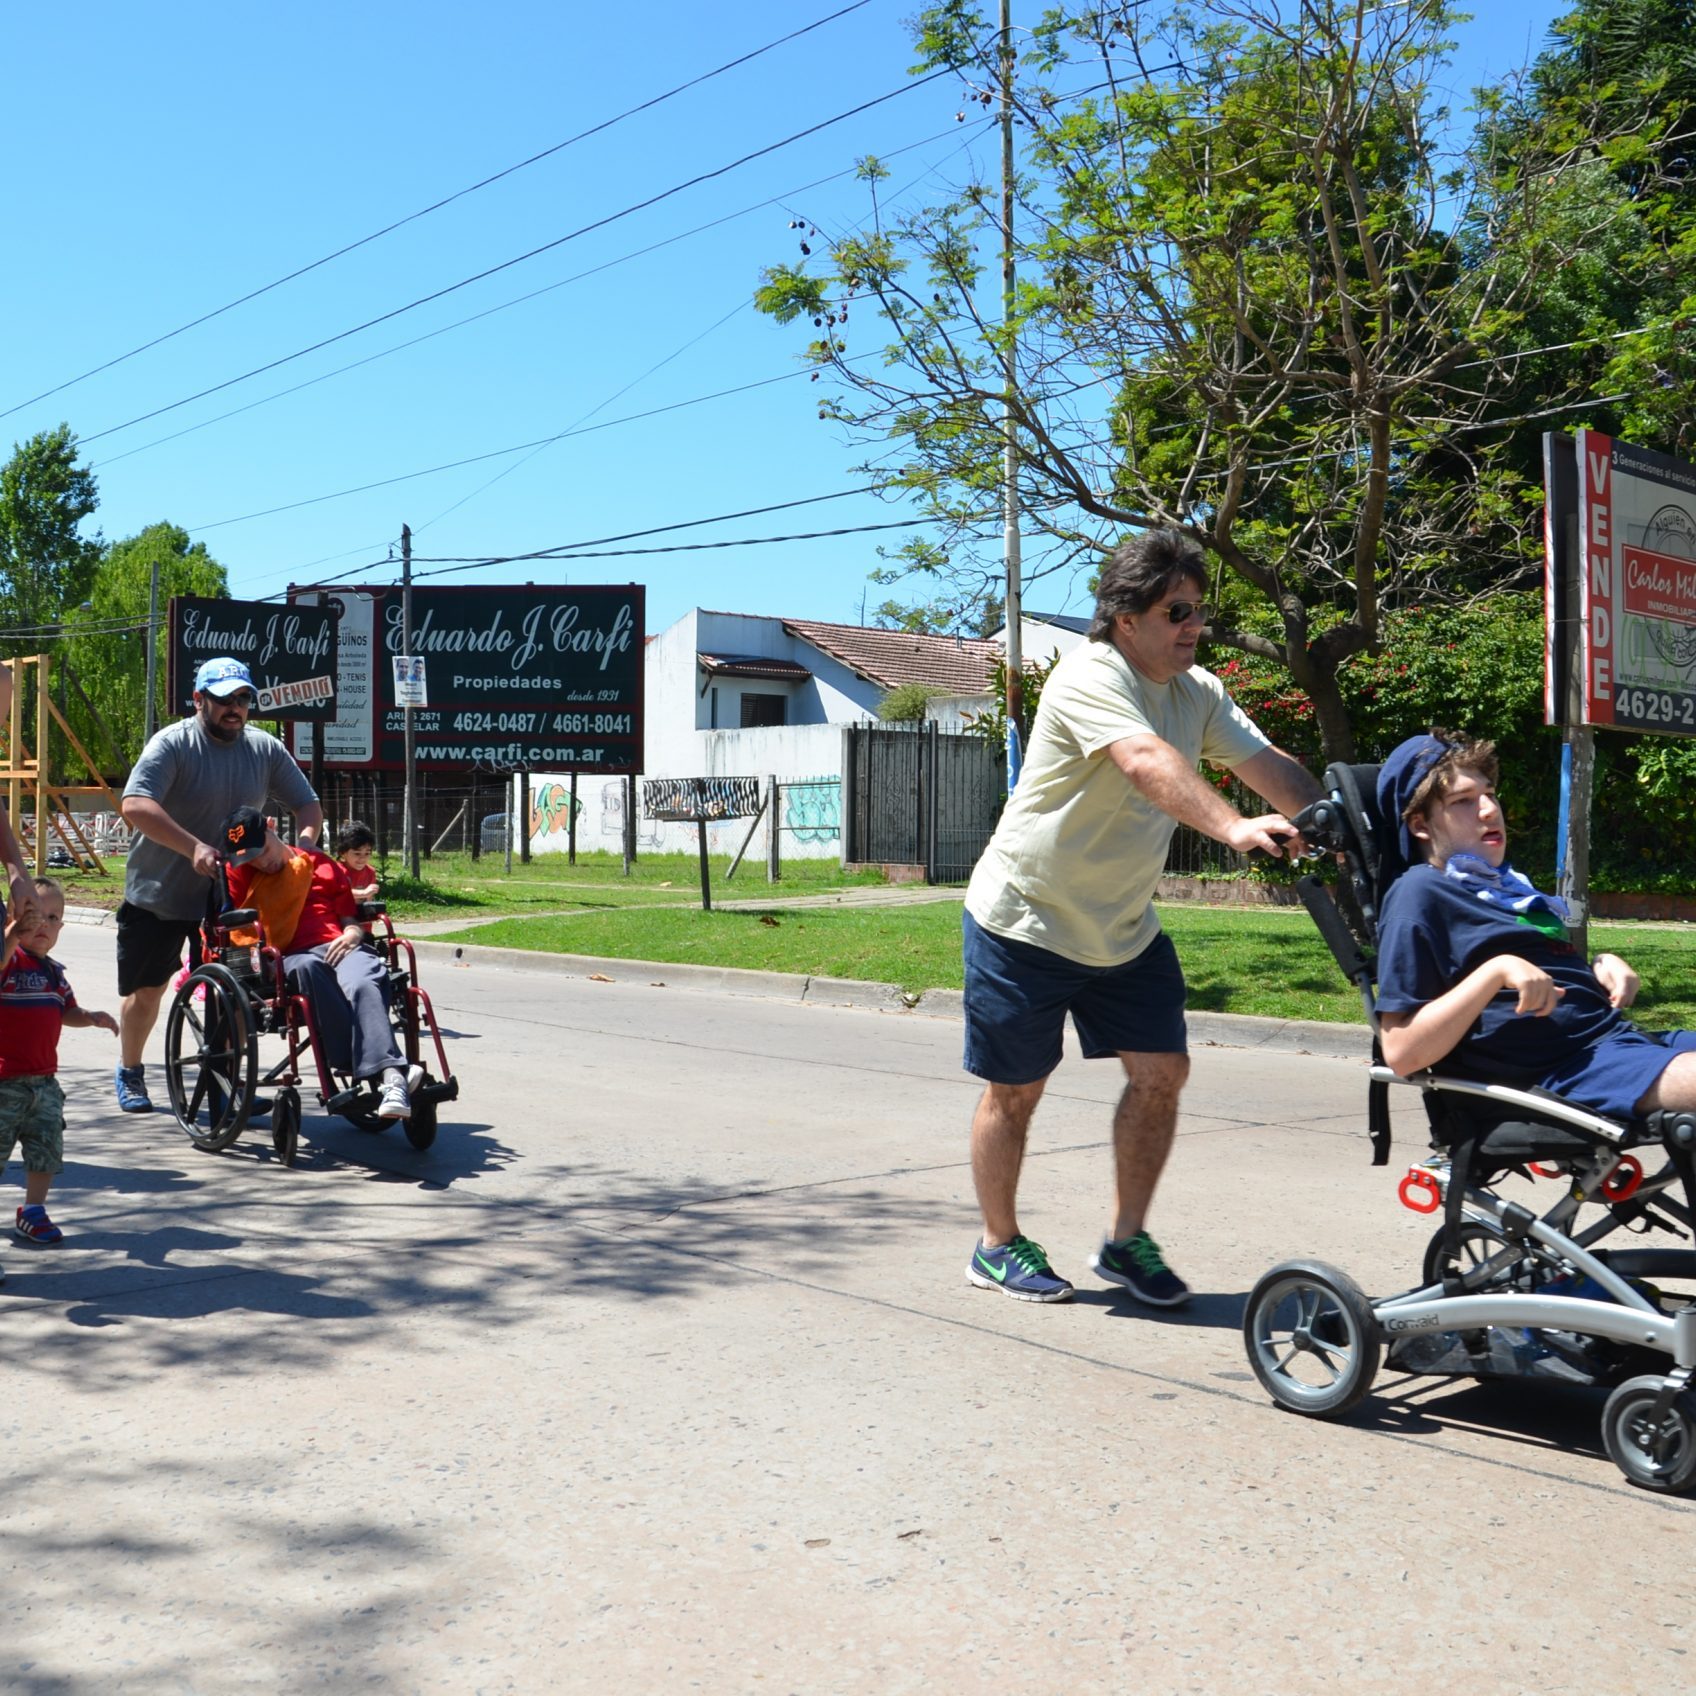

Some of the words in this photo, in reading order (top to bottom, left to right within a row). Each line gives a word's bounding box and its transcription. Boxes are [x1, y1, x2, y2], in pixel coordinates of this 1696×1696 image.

[1611, 450, 1619, 466] 3
[1619, 453, 1665, 478] Generaciones
[1664, 468, 1673, 480] al
[1588, 450, 1611, 701] VENDE
[1627, 559, 1673, 596] Carlos
[183, 608, 258, 651] Eduardo
[259, 613, 280, 666] J.
[283, 614, 331, 670] Carfi
[385, 604, 515, 655] Eduardo
[510, 604, 547, 671] J.
[550, 604, 635, 671] Carfi
[453, 675, 562, 691] Propiedades
[566, 690, 595, 702] desde
[596, 689, 620, 702] 1931
[386, 711, 418, 720] ARIS
[420, 712, 441, 720] 2671
[1615, 688, 1695, 725] 4629-2
[386, 722, 440, 731] CASELAR
[453, 712, 536, 732] 4624-0487
[552, 713, 631, 734] 4661-8041
[415, 743, 605, 762] www.carfi.com.ar
